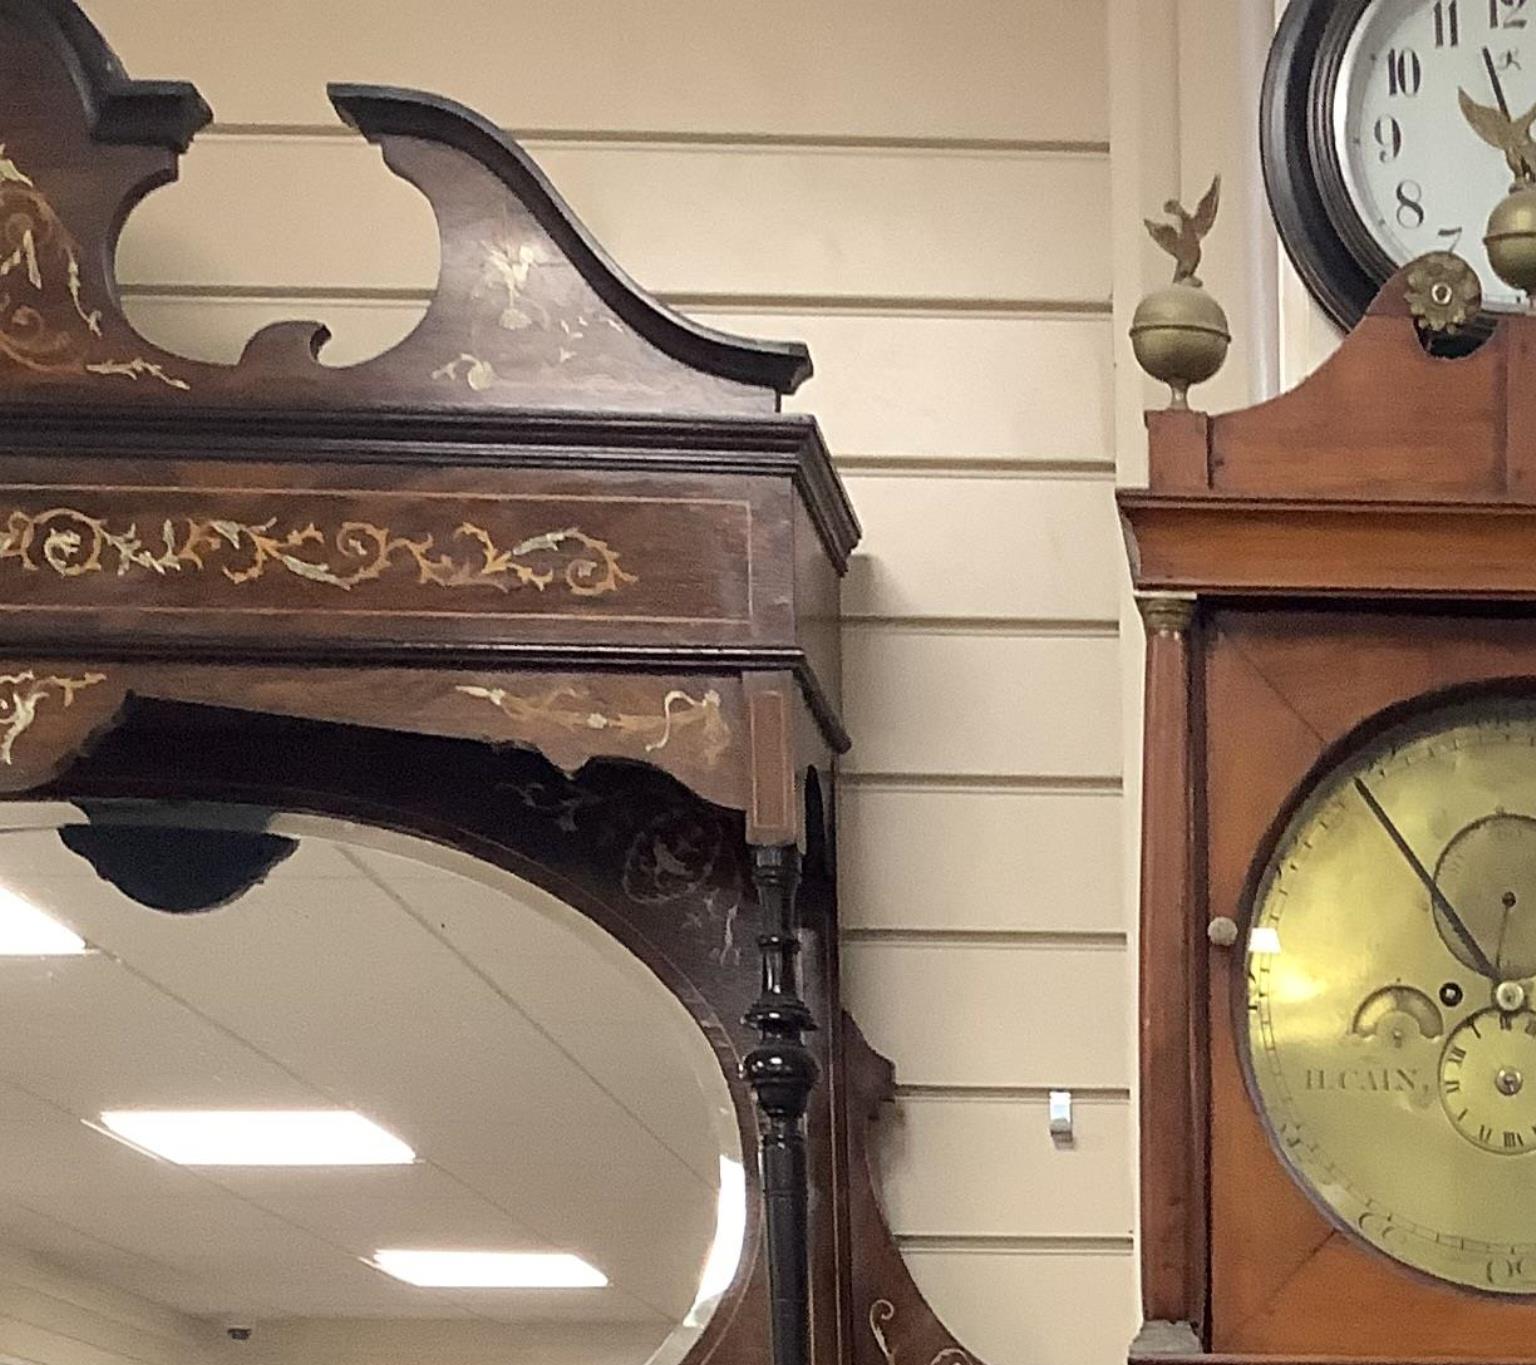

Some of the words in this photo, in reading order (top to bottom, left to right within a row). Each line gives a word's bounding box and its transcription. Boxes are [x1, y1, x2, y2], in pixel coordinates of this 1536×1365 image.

[1433, 0, 1459, 47] 11
[1388, 47, 1422, 98] 10
[1373, 113, 1402, 164] 9
[1395, 179, 1425, 230] 8
